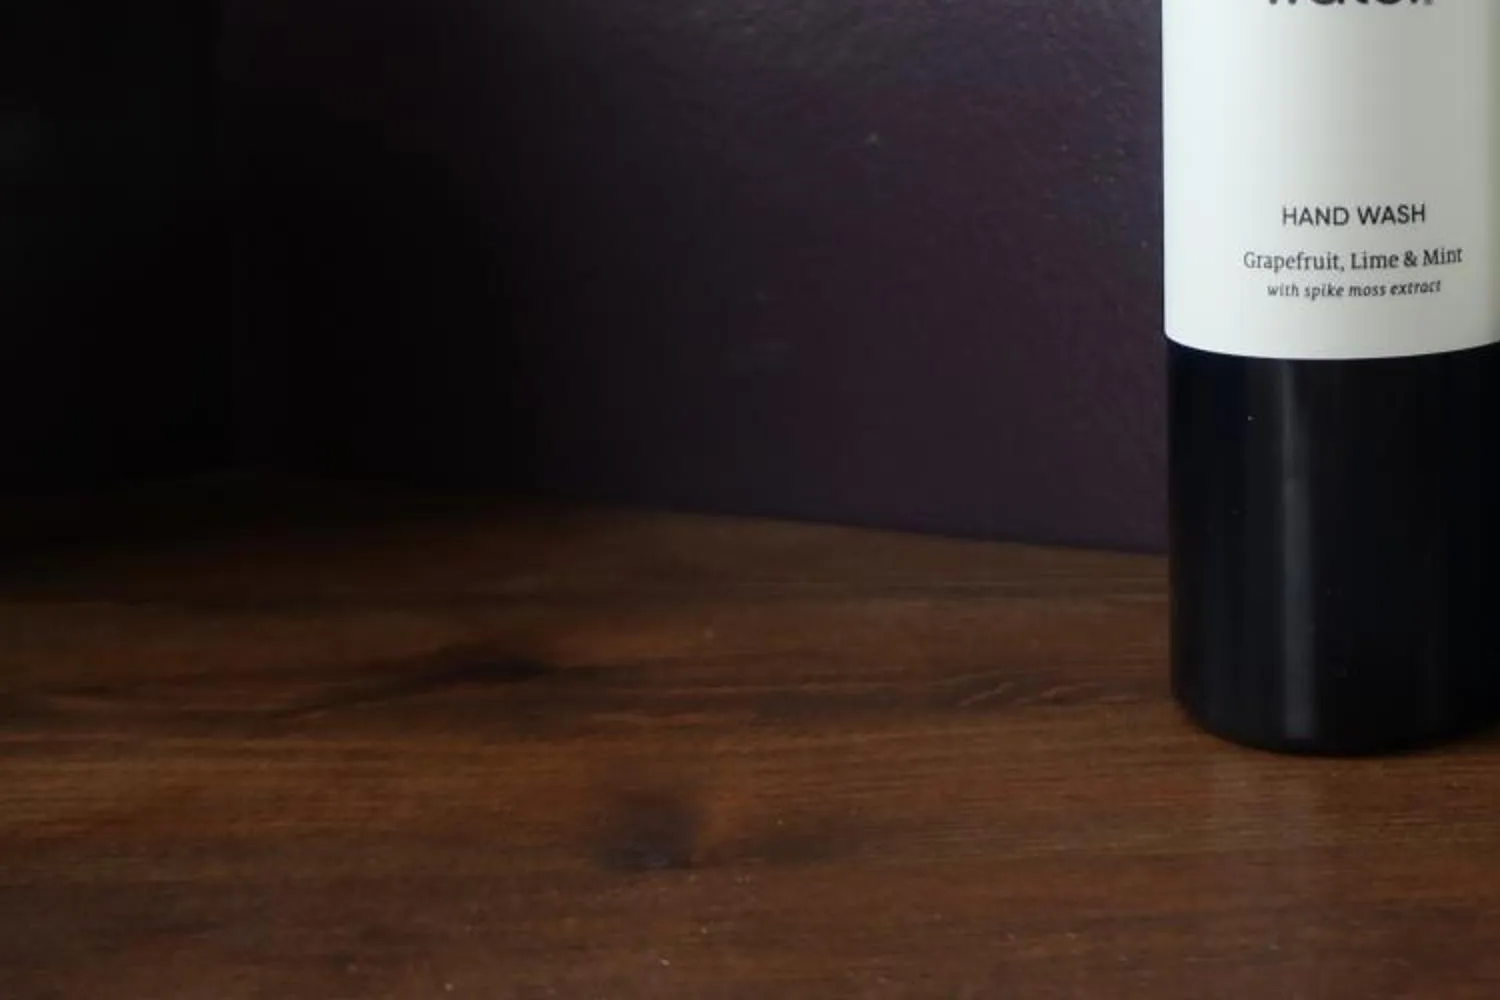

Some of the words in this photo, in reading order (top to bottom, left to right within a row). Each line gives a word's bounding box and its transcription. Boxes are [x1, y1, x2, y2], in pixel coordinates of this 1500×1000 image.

[1281, 206, 1351, 227] HAND
[1356, 203, 1427, 226] WASH
[1242, 251, 1346, 274] Grapefruit,
[1350, 250, 1401, 271] Lime
[1402, 250, 1420, 269] &
[1421, 246, 1464, 268] Mint
[1266, 282, 1301, 298] with
[1303, 283, 1346, 301] spike
[1347, 284, 1388, 298] moss
[1389, 279, 1443, 297] extract
